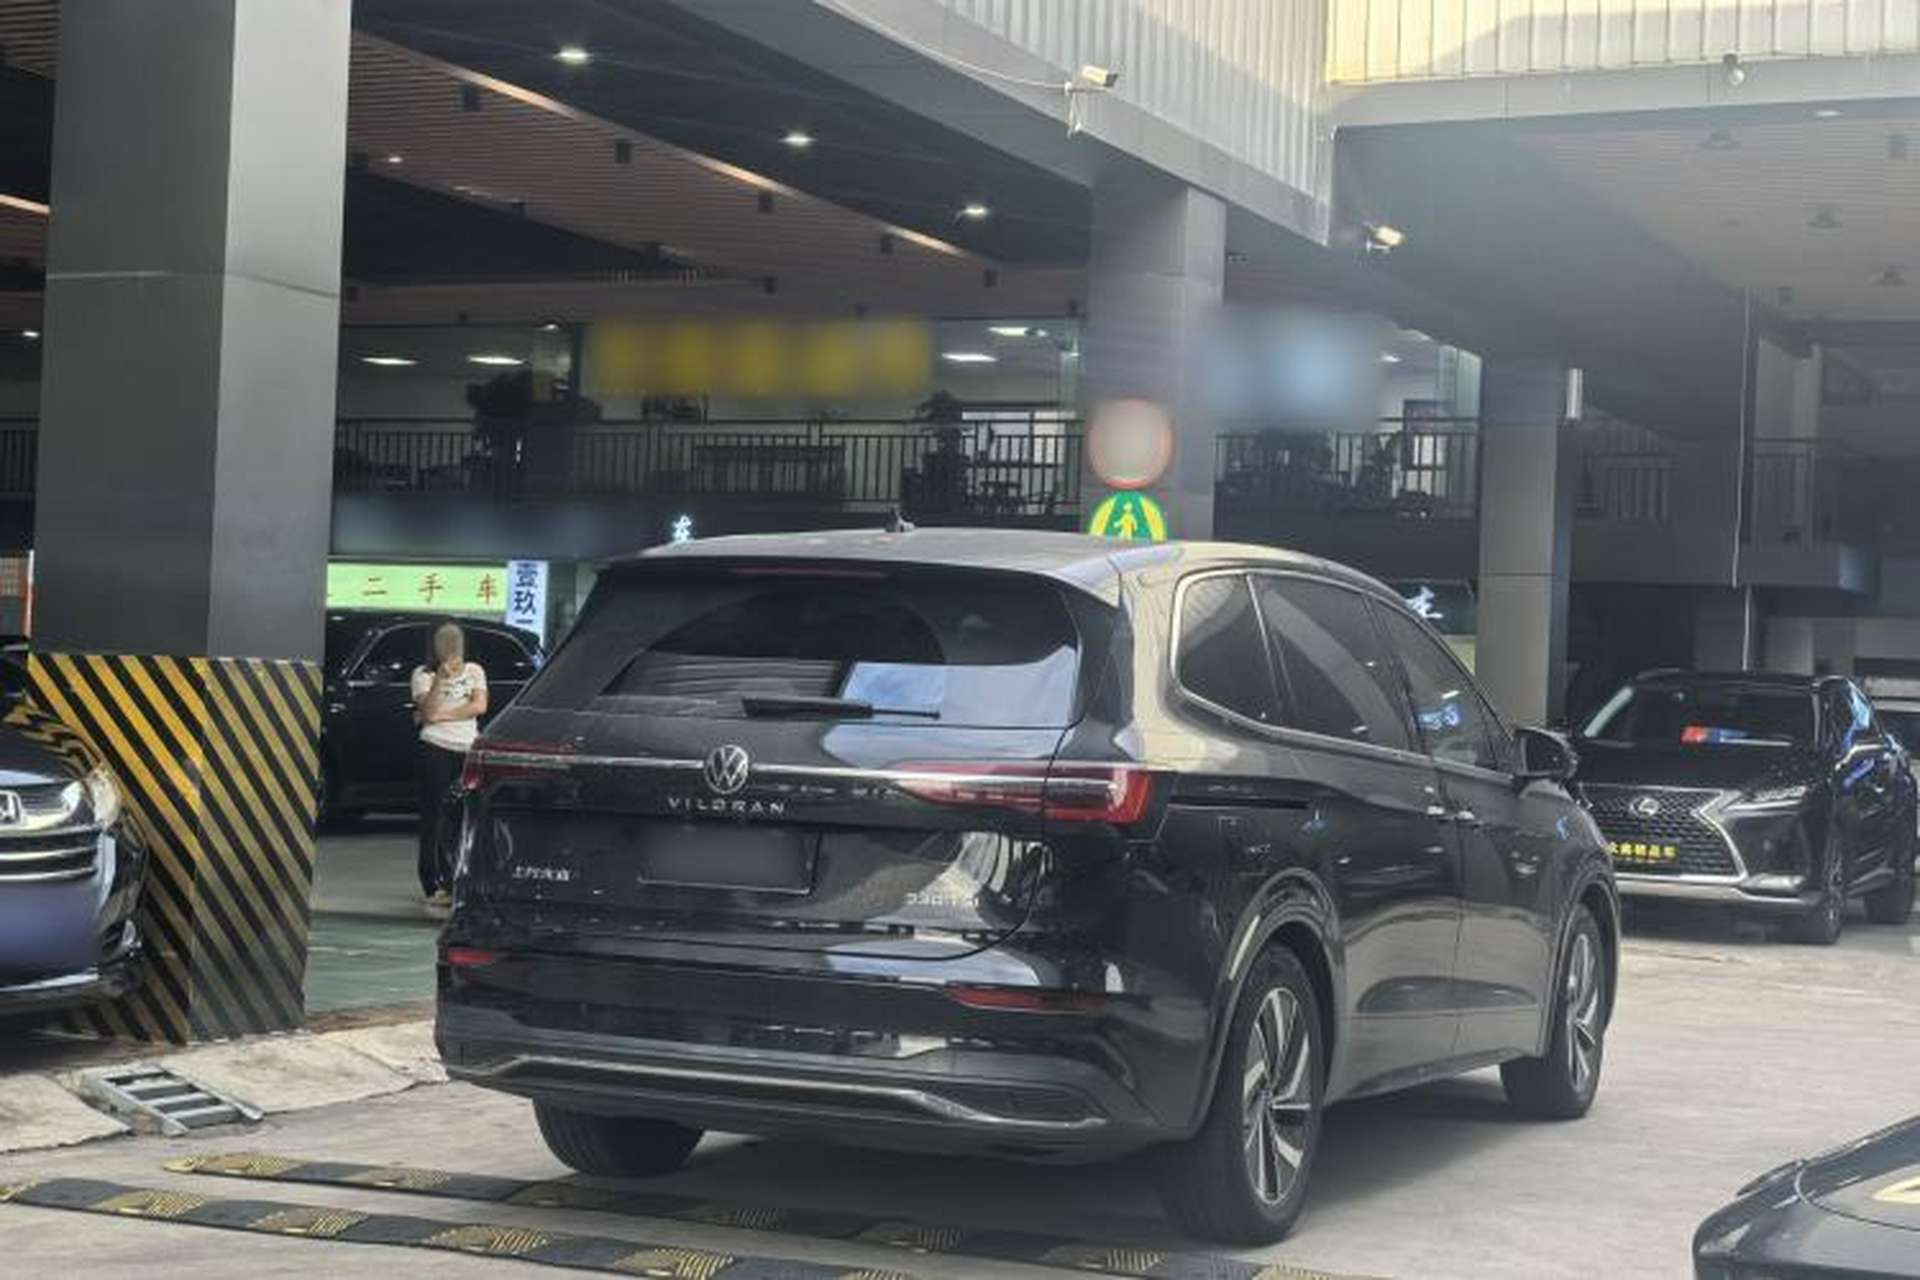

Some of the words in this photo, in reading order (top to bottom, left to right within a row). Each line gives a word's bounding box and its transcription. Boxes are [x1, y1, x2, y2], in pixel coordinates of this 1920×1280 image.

[362, 573, 498, 604] 二手车
[667, 796, 785, 815] VILORAN
